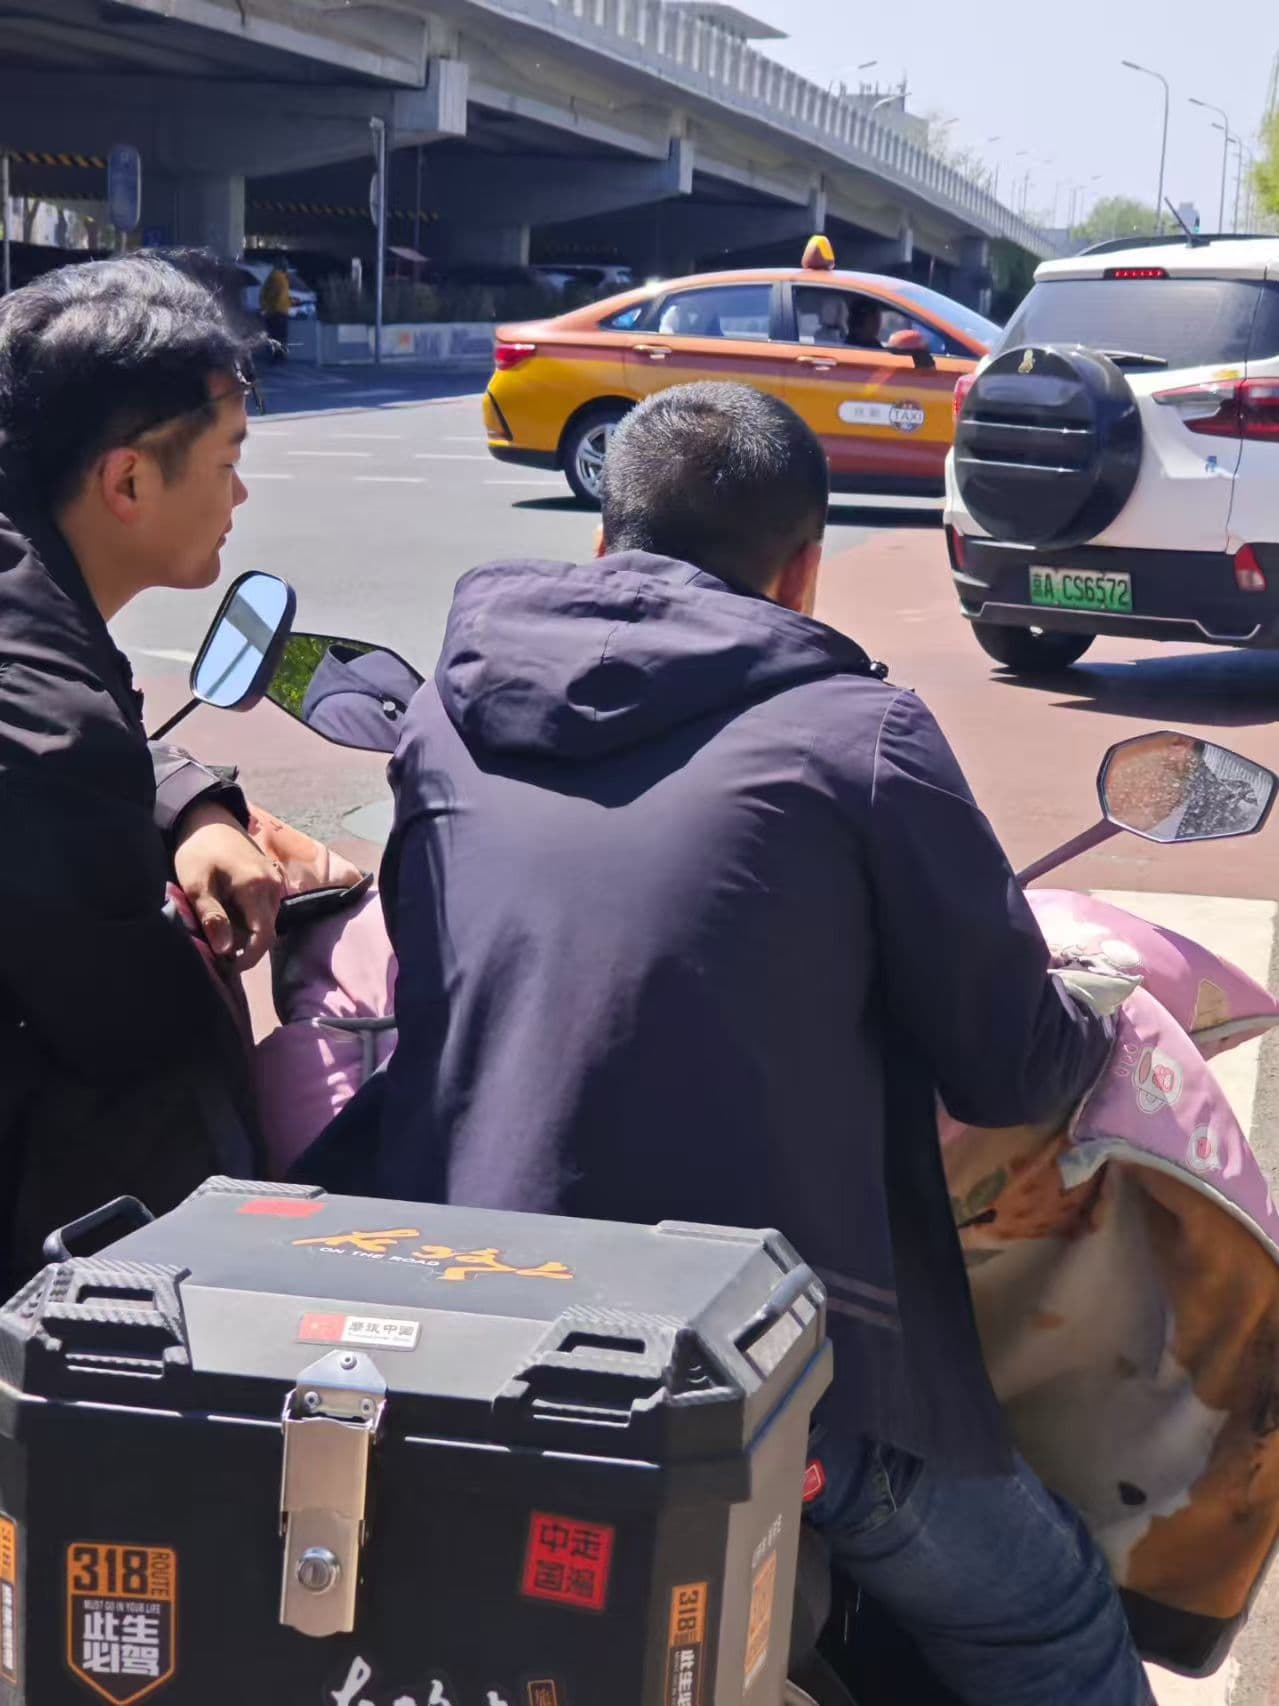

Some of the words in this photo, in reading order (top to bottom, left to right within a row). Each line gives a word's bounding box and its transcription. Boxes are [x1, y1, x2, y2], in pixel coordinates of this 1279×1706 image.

[893, 409, 922, 422] TAXI
[351, 1250, 385, 1259] THE
[389, 1256, 440, 1266] ROAD
[74, 1547, 149, 1594] 318
[151, 1551, 170, 1597] ROUTE
[82, 1611, 160, 1645] 此生
[678, 1590, 699, 1631] 318
[82, 1641, 160, 1676] 必驾
